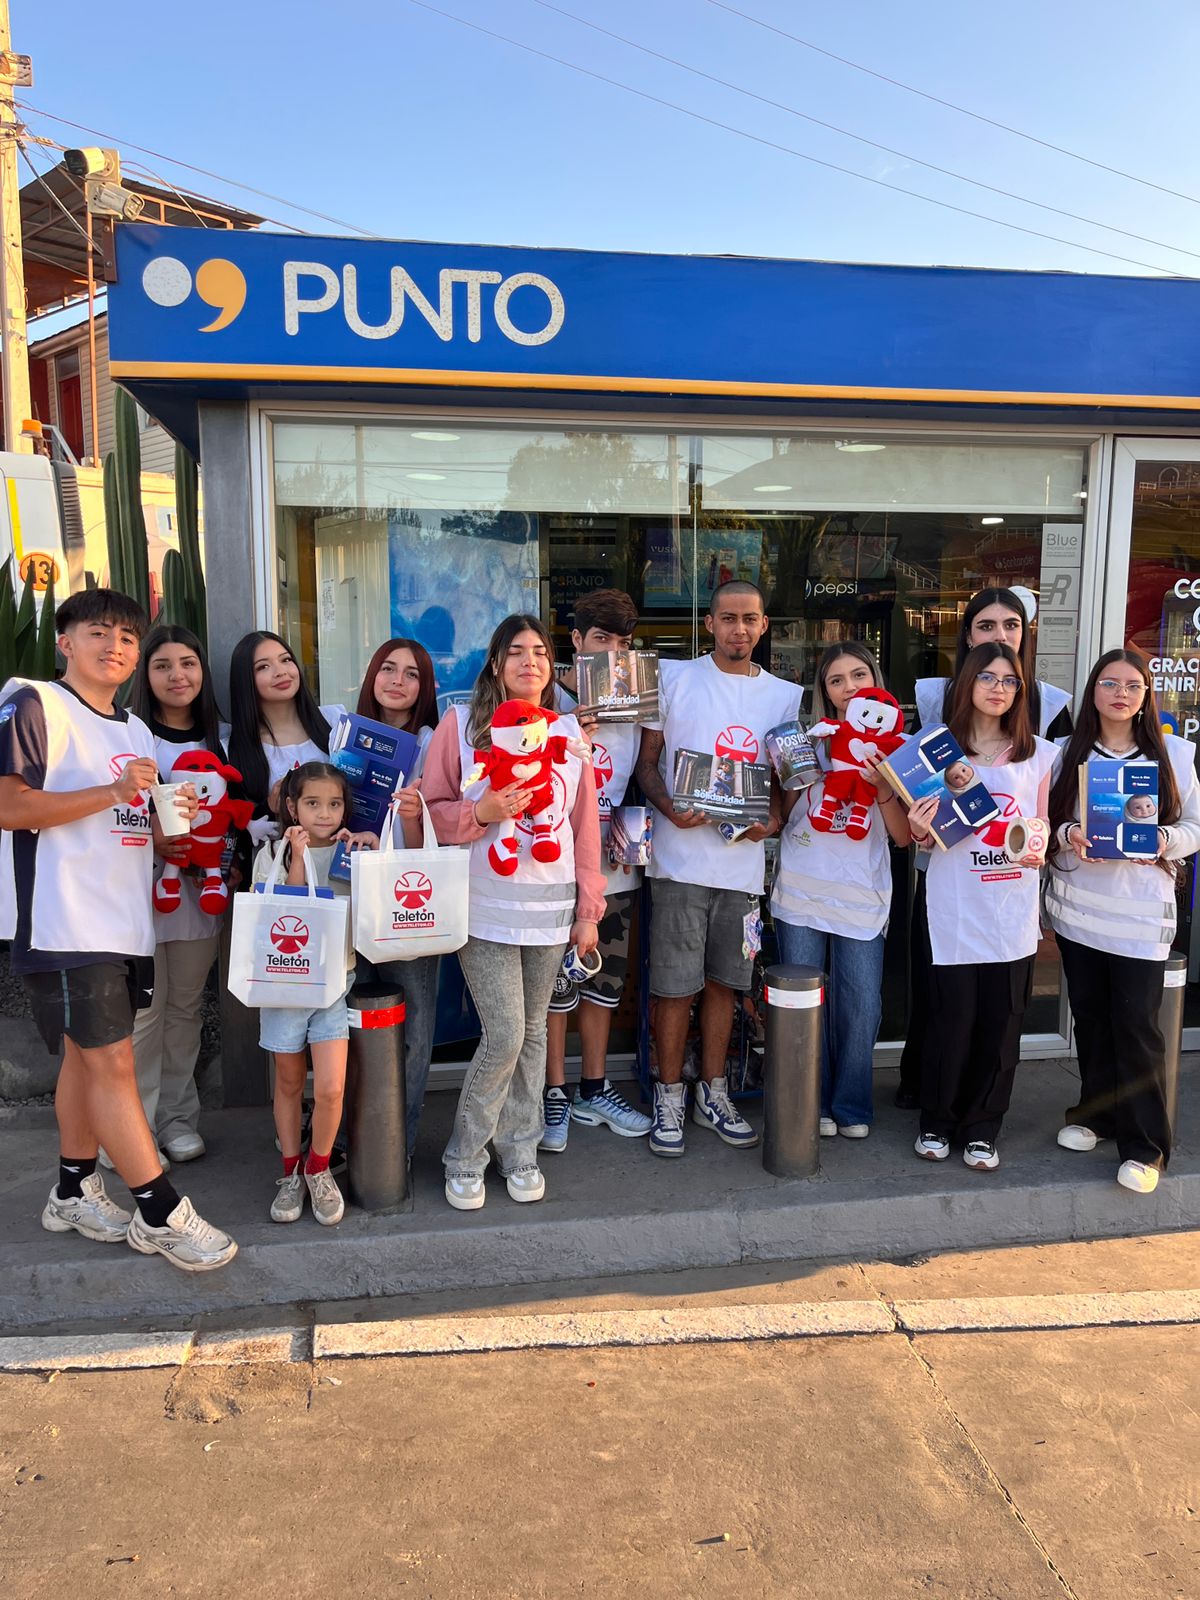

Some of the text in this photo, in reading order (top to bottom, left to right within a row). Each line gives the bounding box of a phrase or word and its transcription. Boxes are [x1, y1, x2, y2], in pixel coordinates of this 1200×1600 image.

[284, 261, 565, 346] PUNTO
[1047, 533, 1078, 546] Blue
[814, 581, 858, 597] pepsi
[1151, 676, 1195, 692] ENIR
[970, 850, 1013, 866] Telet
